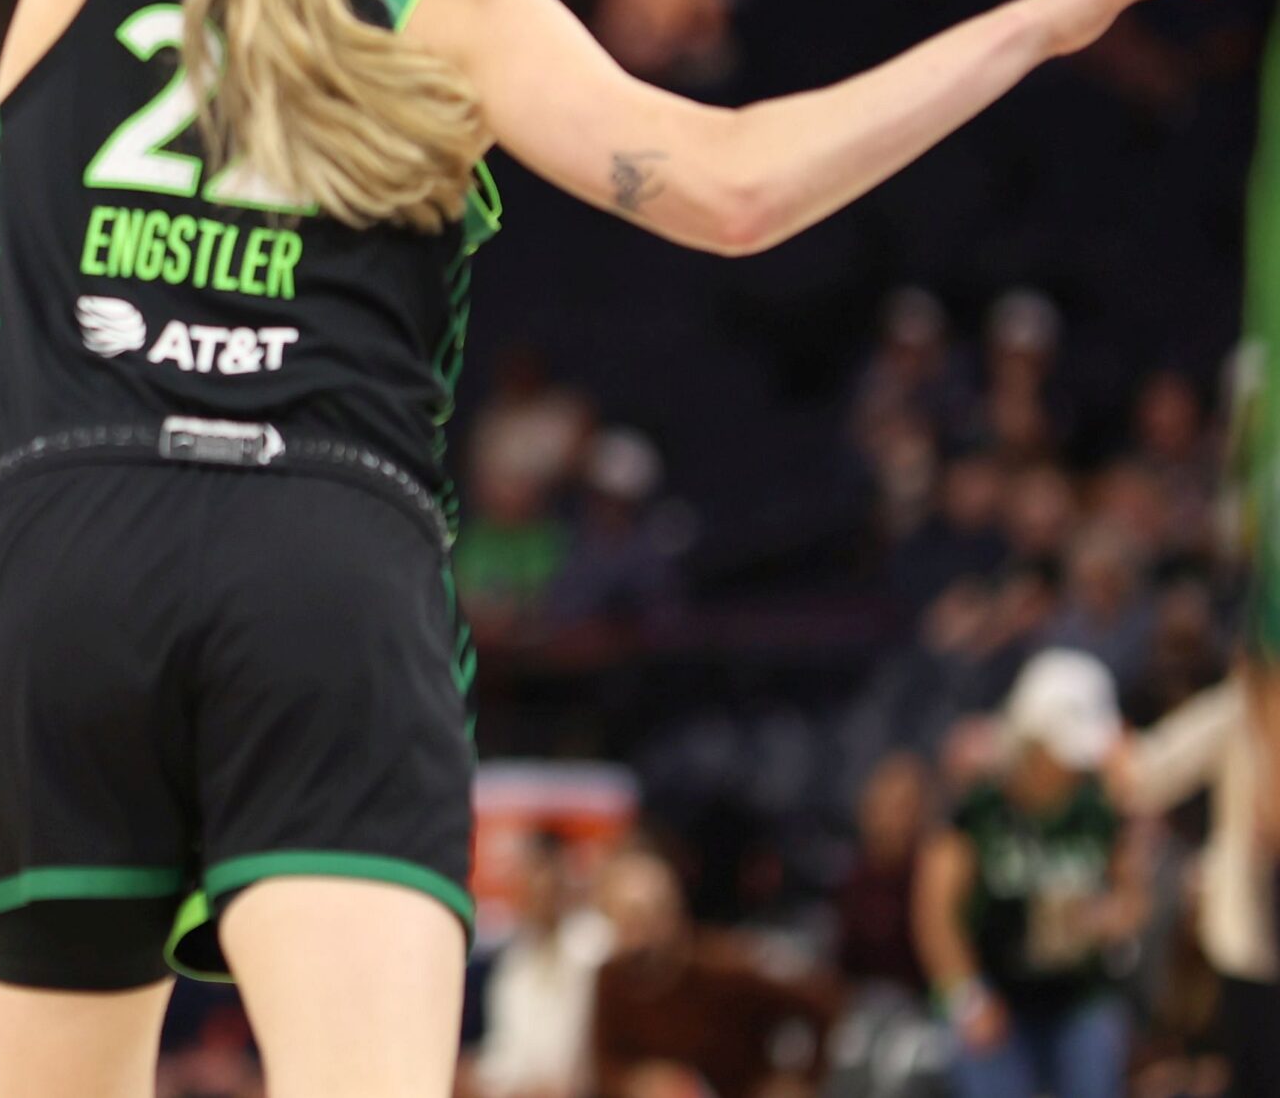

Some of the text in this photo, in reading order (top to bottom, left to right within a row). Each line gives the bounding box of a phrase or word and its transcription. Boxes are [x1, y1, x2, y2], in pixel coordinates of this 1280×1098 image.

[83, 2, 320, 217] 2
[80, 206, 303, 300] ENGSTLER
[147, 320, 299, 374] AT&T
